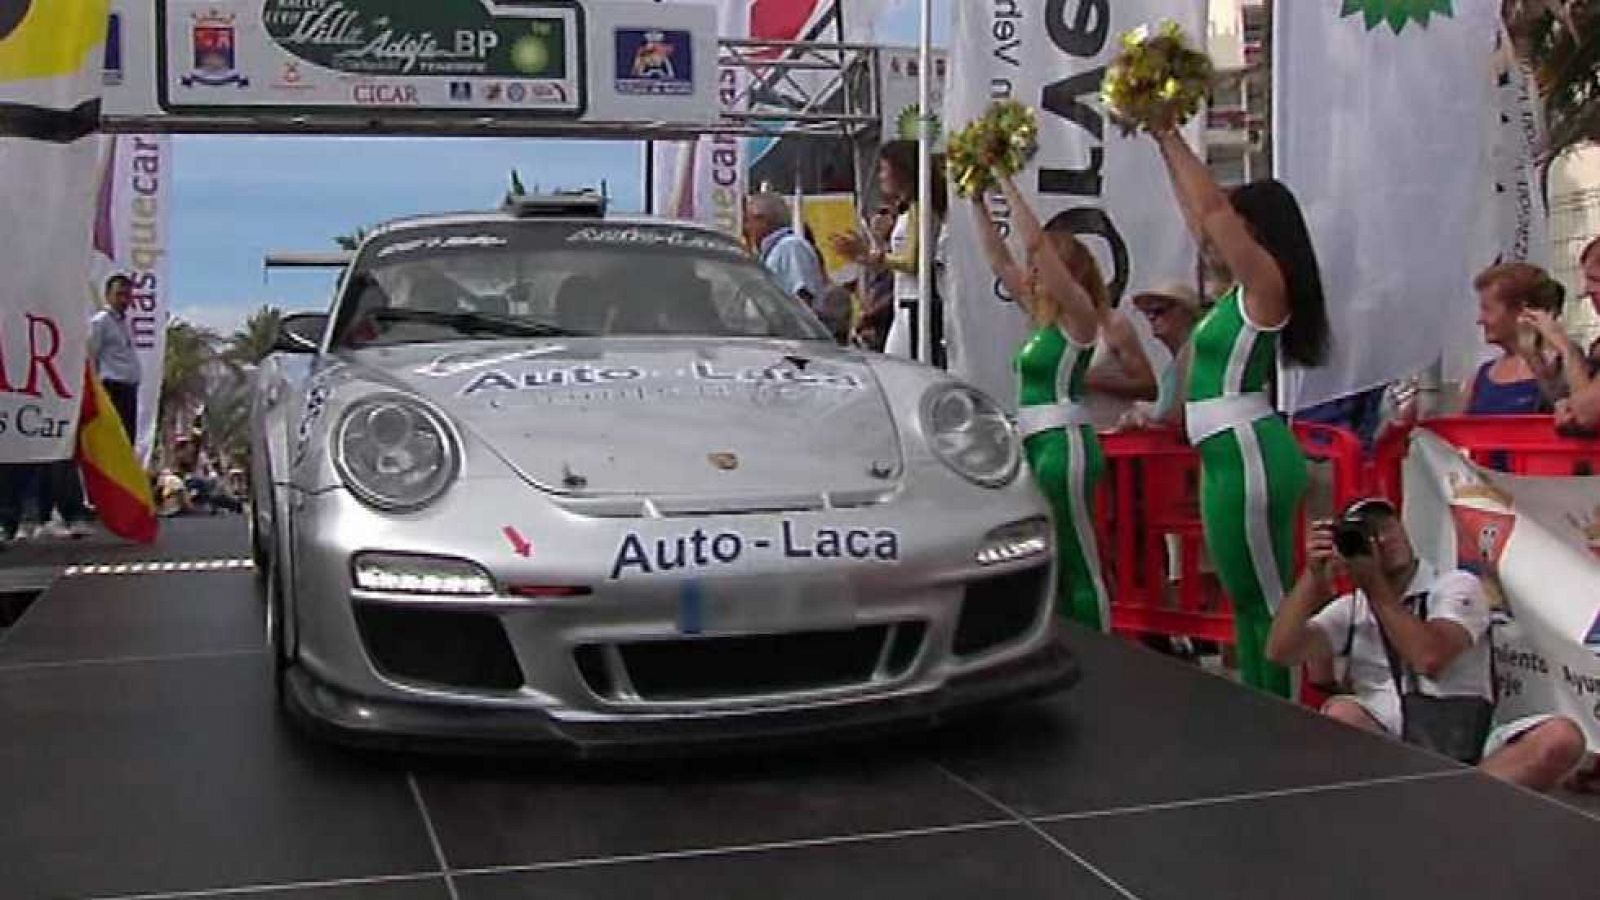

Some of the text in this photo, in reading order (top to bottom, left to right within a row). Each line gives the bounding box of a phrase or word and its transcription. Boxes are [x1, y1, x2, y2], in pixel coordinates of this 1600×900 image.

[454, 30, 498, 58] BP
[353, 84, 420, 102] CICAR
[464, 366, 642, 394] Auto
[15, 404, 69, 437] Car
[609, 528, 742, 580] Auto
[782, 520, 899, 561] Laca
